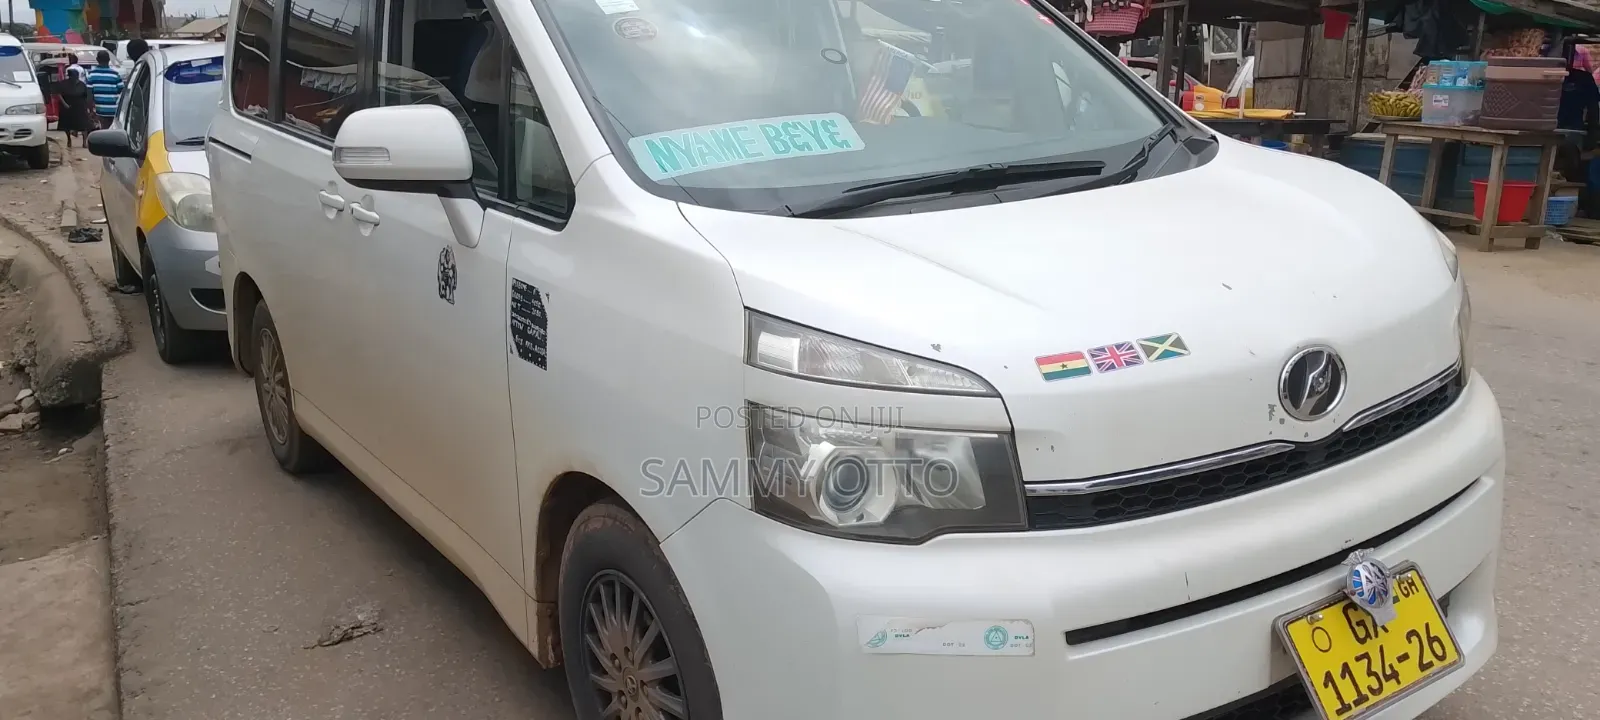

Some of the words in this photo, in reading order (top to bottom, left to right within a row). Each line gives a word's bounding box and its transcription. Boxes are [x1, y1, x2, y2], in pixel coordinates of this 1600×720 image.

[645, 126, 764, 174] NYAME
[1397, 578, 1420, 599] GH
[1323, 622, 1447, 717] 1134-26
